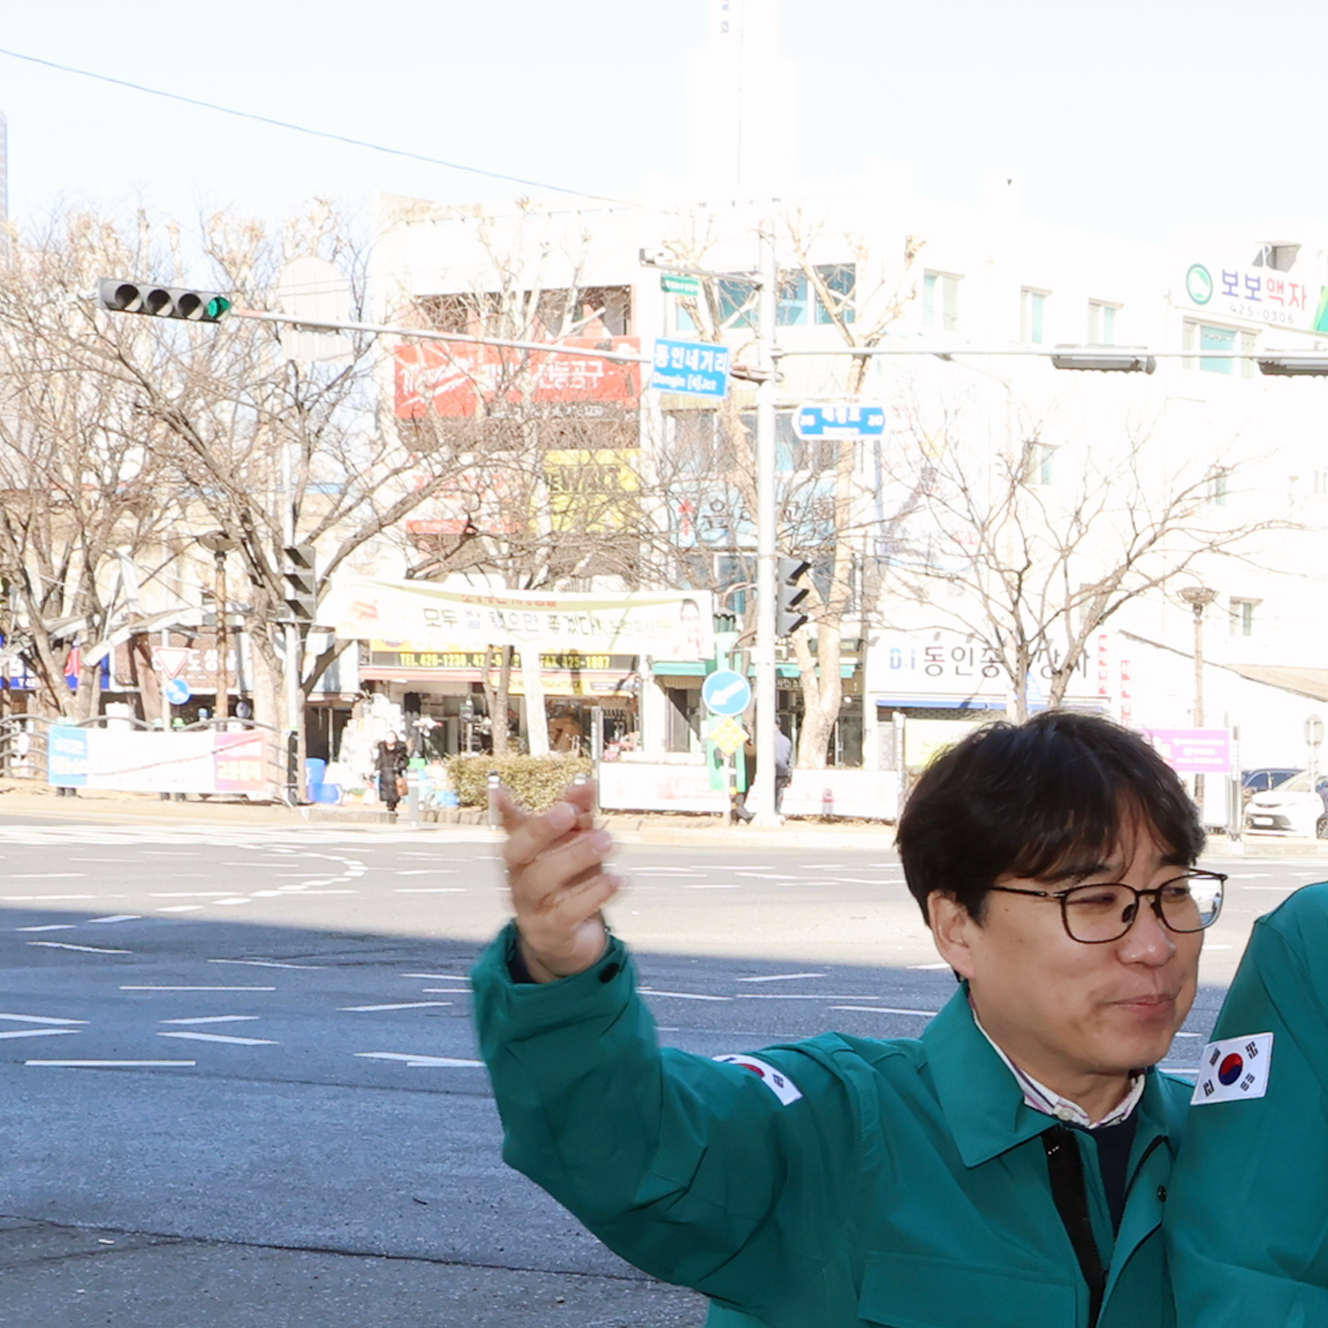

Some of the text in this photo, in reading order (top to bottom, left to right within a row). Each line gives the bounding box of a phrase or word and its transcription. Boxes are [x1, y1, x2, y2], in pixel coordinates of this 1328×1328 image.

[1221, 269, 1308, 311] 보보액자
[1229, 302, 1295, 325] 425-0306
[655, 344, 728, 376] 동인네거리
[653, 372, 686, 389] Dongin
[423, 607, 459, 630] 모두
[924, 646, 1091, 680] 동인종상사
